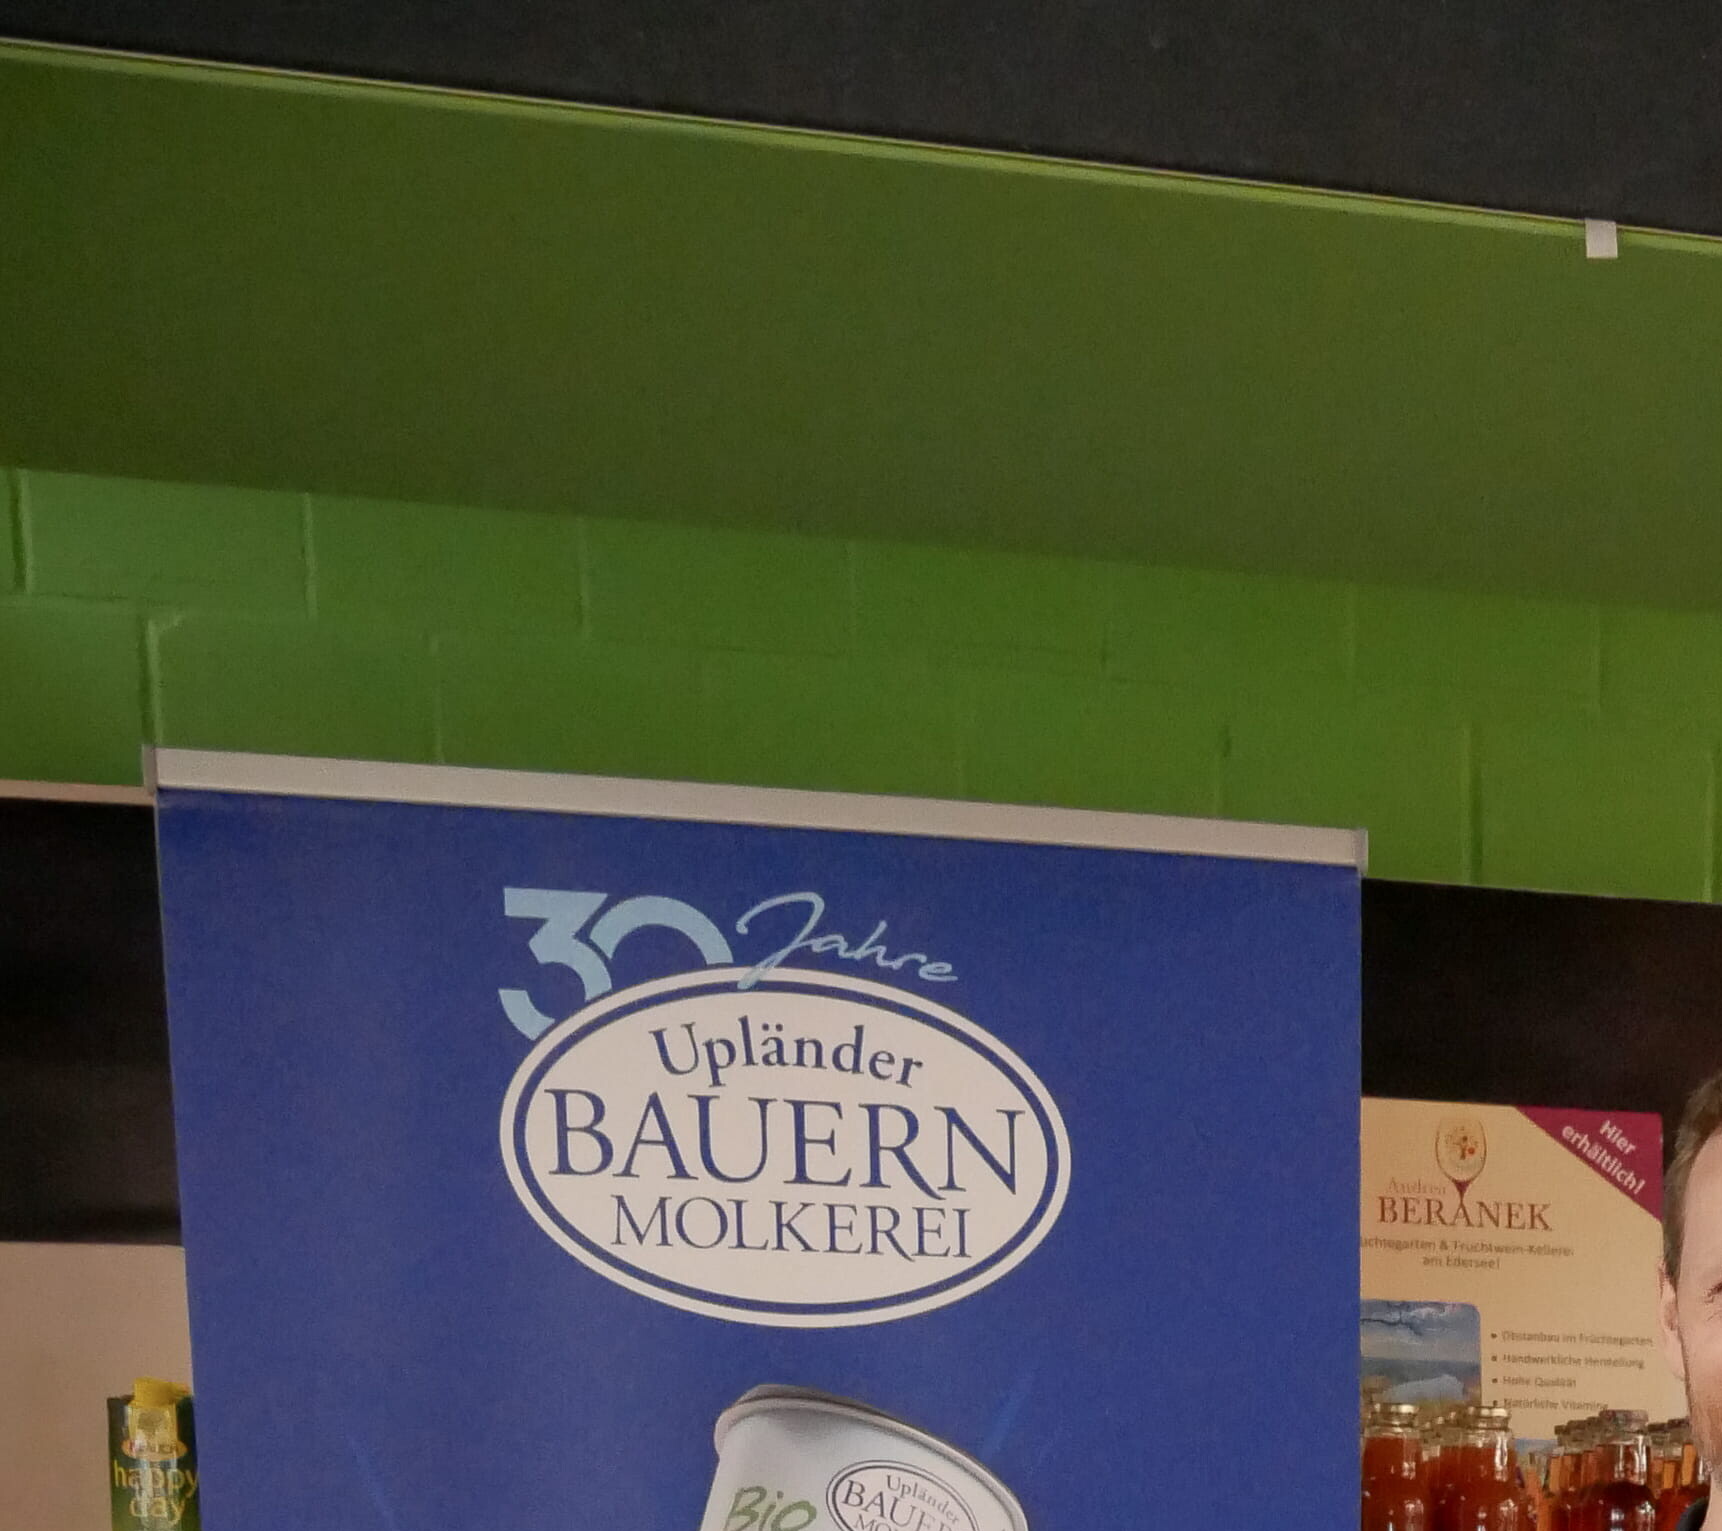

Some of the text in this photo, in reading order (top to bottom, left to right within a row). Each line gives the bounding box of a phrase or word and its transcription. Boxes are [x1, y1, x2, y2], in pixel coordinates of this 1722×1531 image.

[499, 887, 957, 1040] 30 Jahre
[652, 1016, 922, 1087] Upländer
[544, 1089, 1025, 1200] BAUERN
[1562, 1125, 1645, 1195] erhältlich!
[1600, 1120, 1636, 1156] Hier
[610, 1195, 971, 1262] MOLKEREI
[1377, 1196, 1553, 1232] BERANEK
[129, 1493, 187, 1527] day
[886, 1475, 959, 1524] Upländer
